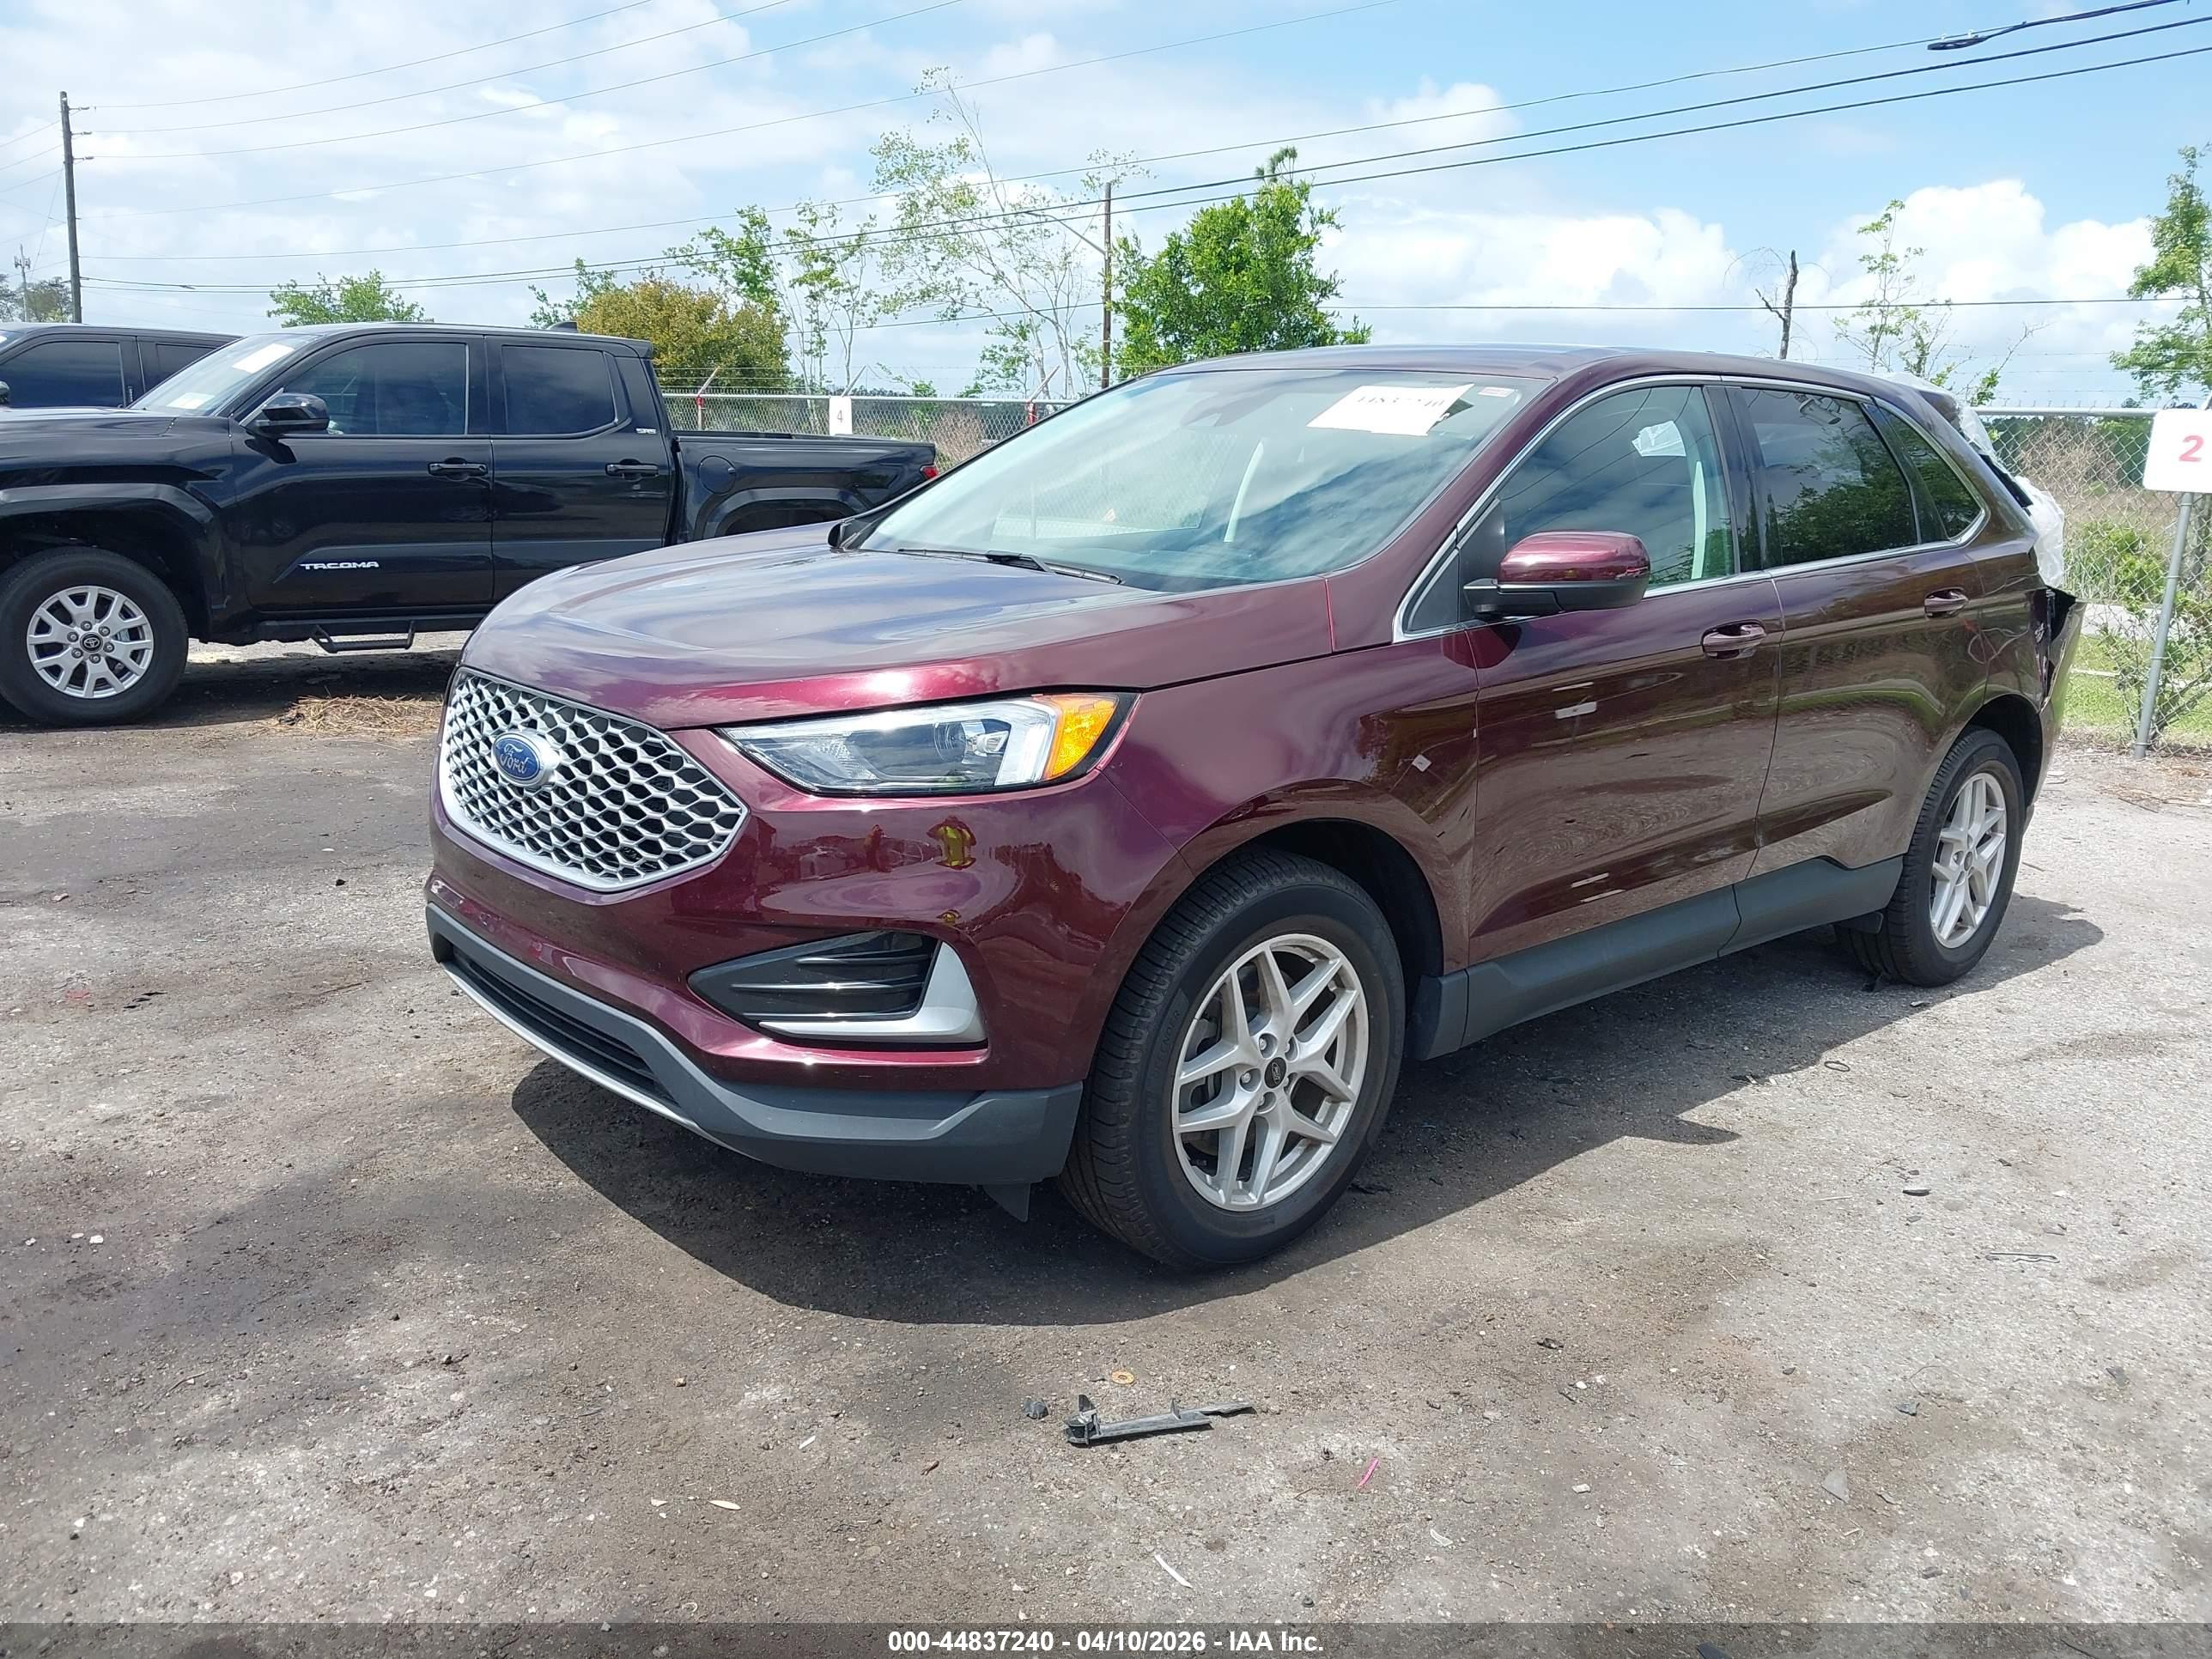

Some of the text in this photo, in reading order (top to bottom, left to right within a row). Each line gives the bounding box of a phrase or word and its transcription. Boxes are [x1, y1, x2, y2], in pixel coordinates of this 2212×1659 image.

[836, 410, 843, 423] 4
[2179, 434, 2204, 462] 2
[298, 561, 380, 570] TACOMA
[501, 743, 532, 774] Ford
